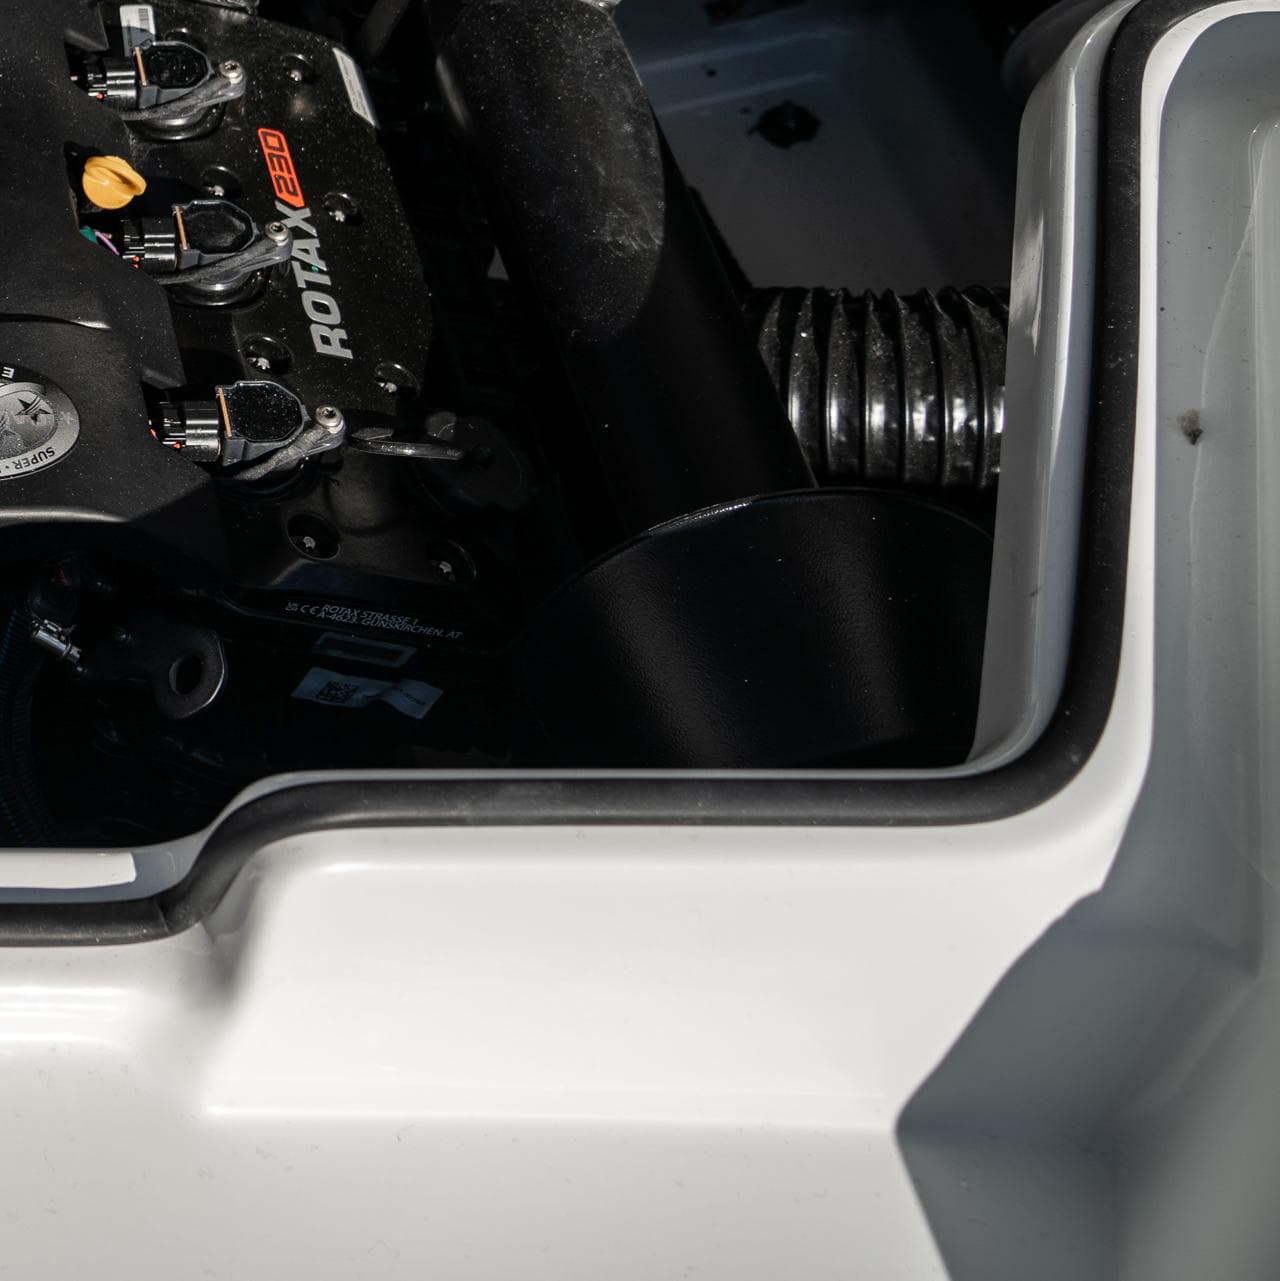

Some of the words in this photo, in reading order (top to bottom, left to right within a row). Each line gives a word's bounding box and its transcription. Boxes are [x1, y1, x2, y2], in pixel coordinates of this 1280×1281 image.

[257, 127, 306, 209] 230
[274, 199, 353, 360] ROTAX
[12, 446, 56, 469] SUPER
[321, 605, 359, 618] ROTAX
[359, 610, 412, 623] STRASSE
